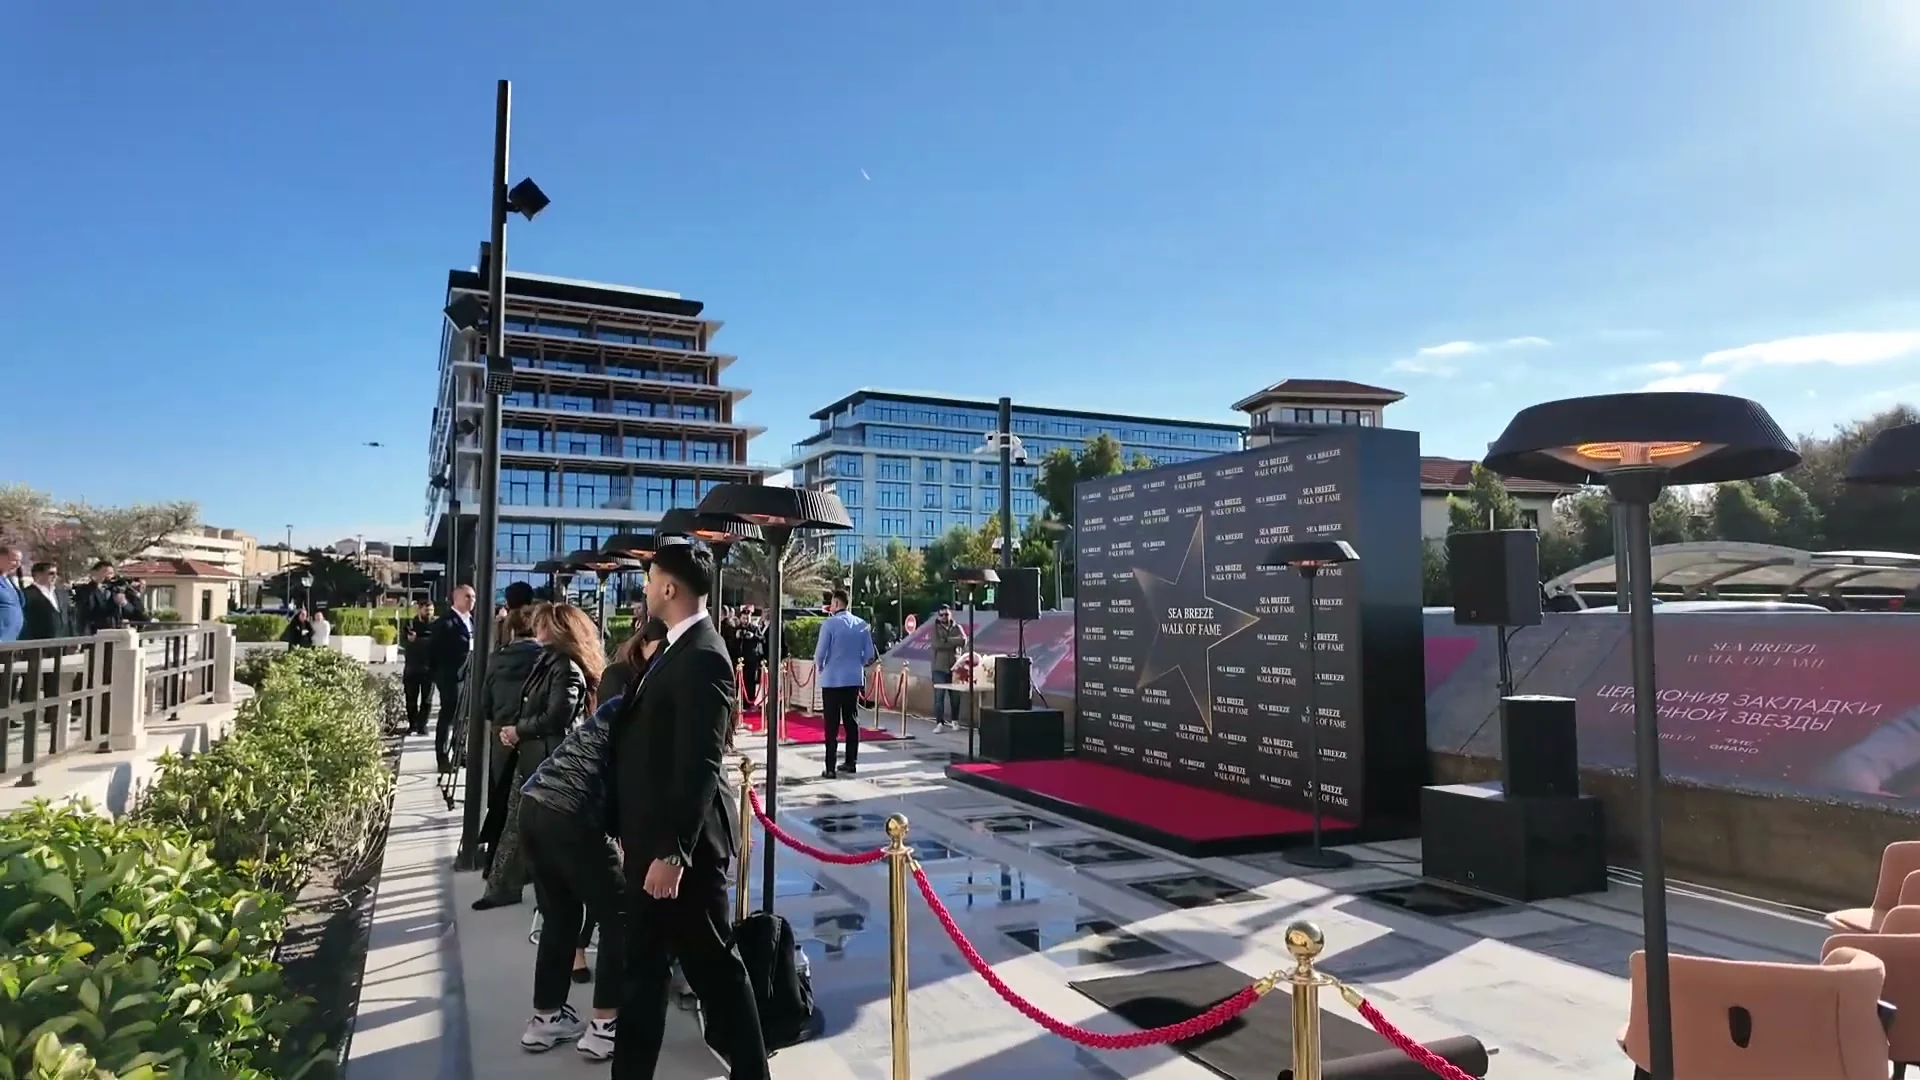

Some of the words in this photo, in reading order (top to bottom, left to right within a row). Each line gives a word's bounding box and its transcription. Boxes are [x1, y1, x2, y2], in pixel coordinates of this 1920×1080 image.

[1259, 459, 1268, 467] SEA
[1270, 455, 1289, 465] BREEZE
[1306, 453, 1316, 461] SEA
[1255, 468, 1270, 477] WALK
[1279, 464, 1293, 473] FAME
[1302, 487, 1313, 495] SEA
[1314, 484, 1336, 493] BREEZE
[1298, 497, 1314, 506] WALK
[1325, 493, 1341, 502] FAME
[1270, 525, 1289, 534] BREEZE
[1255, 537, 1270, 545] WALK
[1279, 535, 1294, 543] FAME
[1326, 568, 1342, 576] FAME
[1168, 607, 1184, 619] SEA
[1184, 607, 1215, 619] BREEZE
[1161, 623, 1184, 635] WALK
[1185, 623, 1198, 635] OF
[1198, 624, 1222, 636] FAME
[1272, 667, 1291, 675] BREEZE
[1257, 675, 1272, 683] WALK
[1282, 677, 1296, 685] FAME
[1322, 673, 1345, 681] BREEZE
[1597, 684, 1730, 705] ЦЕРОНИЯ
[1733, 693, 1883, 716] ЗАКЛАДКИ
[1609, 702, 1728, 722] ИМННОЙ
[1731, 711, 1833, 732] ЗВЕЗДЫ
[1329, 719, 1346, 728] FAME
[1263, 736, 1272, 744] SEA
[1274, 738, 1293, 748] BREEZE
[1259, 745, 1274, 754] WALK
[1283, 749, 1298, 759] FAME
[1323, 749, 1347, 759] BREEZE
[1709, 744, 1759, 754] GRAND
[1331, 796, 1348, 806] FAME
